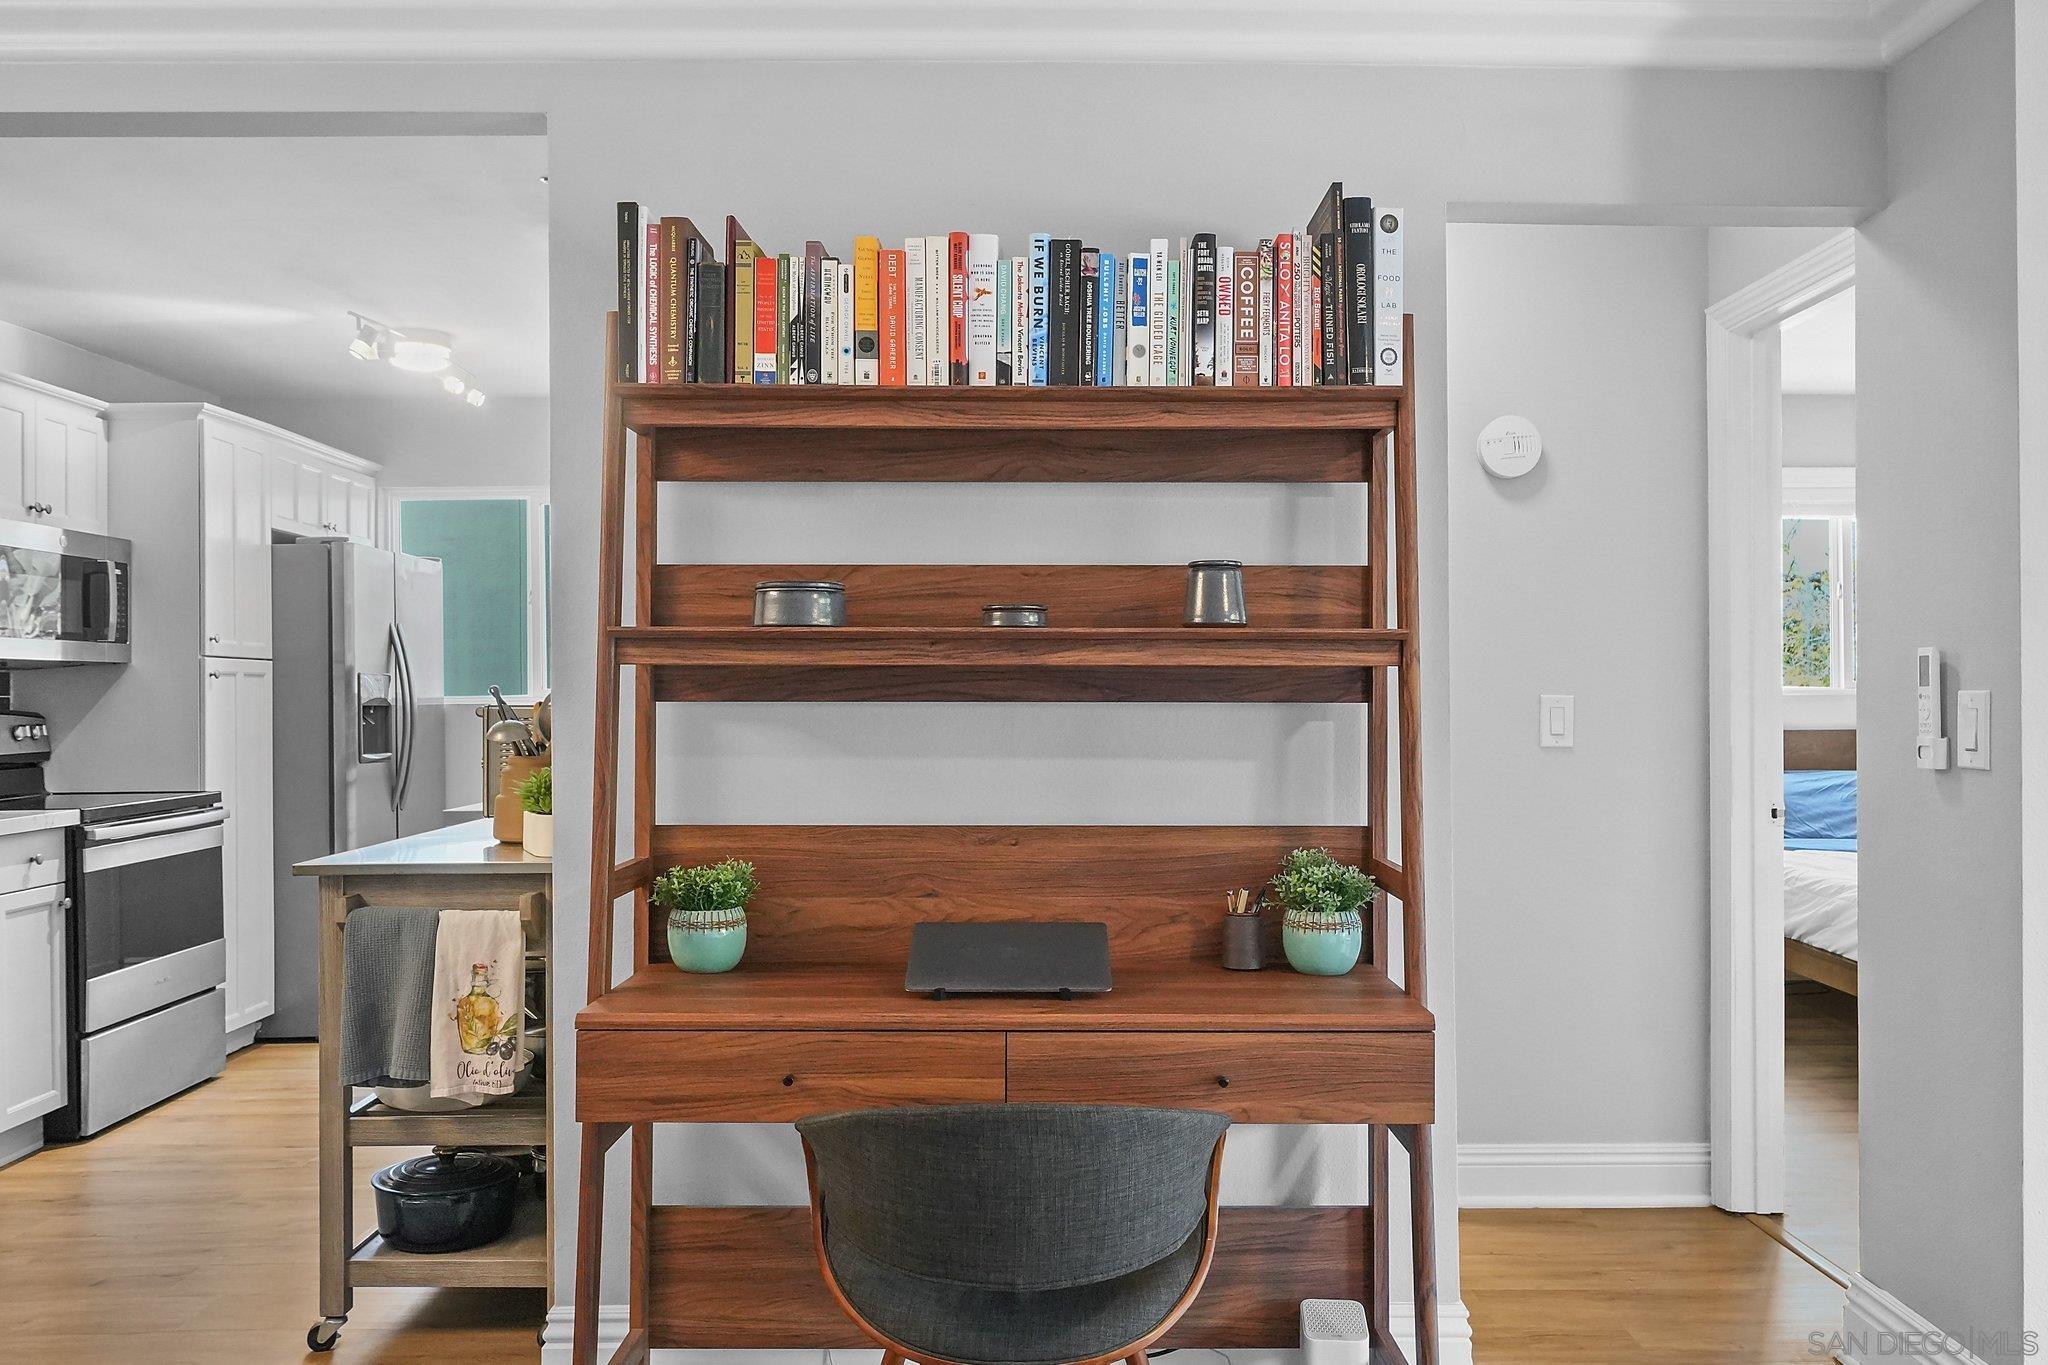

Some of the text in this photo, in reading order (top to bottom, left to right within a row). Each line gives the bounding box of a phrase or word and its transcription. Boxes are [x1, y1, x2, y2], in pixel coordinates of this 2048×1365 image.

[649, 243, 658, 257] The
[888, 254, 897, 278] DEBT
[1197, 249, 1210, 257] FORT
[649, 257, 658, 279] LOGIC
[669, 257, 677, 296] QUANTUM
[1033, 239, 1044, 329] IF WE BURN
[1302, 256, 1311, 295] BRIGHTY
[824, 268, 832, 305] HEMINGWAY
[952, 274, 963, 299] SILENT
[1218, 276, 1232, 316] OWNED
[1304, 295, 1309, 303] OF
[1324, 273, 1333, 297] Magic
[1356, 263, 1367, 324] OROLOGI SOLARI
[649, 288, 658, 325] CHEMICAL
[914, 277, 924, 330] MANUFACTURING
[952, 300, 963, 318] COUP
[1116, 300, 1125, 330] BETTER
[1196, 310, 1209, 318] SETH
[1240, 266, 1254, 338] COFFEE
[1262, 292, 1271, 336] FIERY FERMENTS
[1279, 242, 1290, 366] SOLO ANITA LO
[1153, 292, 1164, 365] THE GILDED CAGE
[1169, 315, 1177, 335] KURT
[1325, 304, 1333, 340] TINNED
[649, 326, 658, 365] SYNTHESIS
[914, 331, 924, 361] CONSENT
[1326, 342, 1334, 365] FISH
[457, 1060, 480, 1079] Olio
